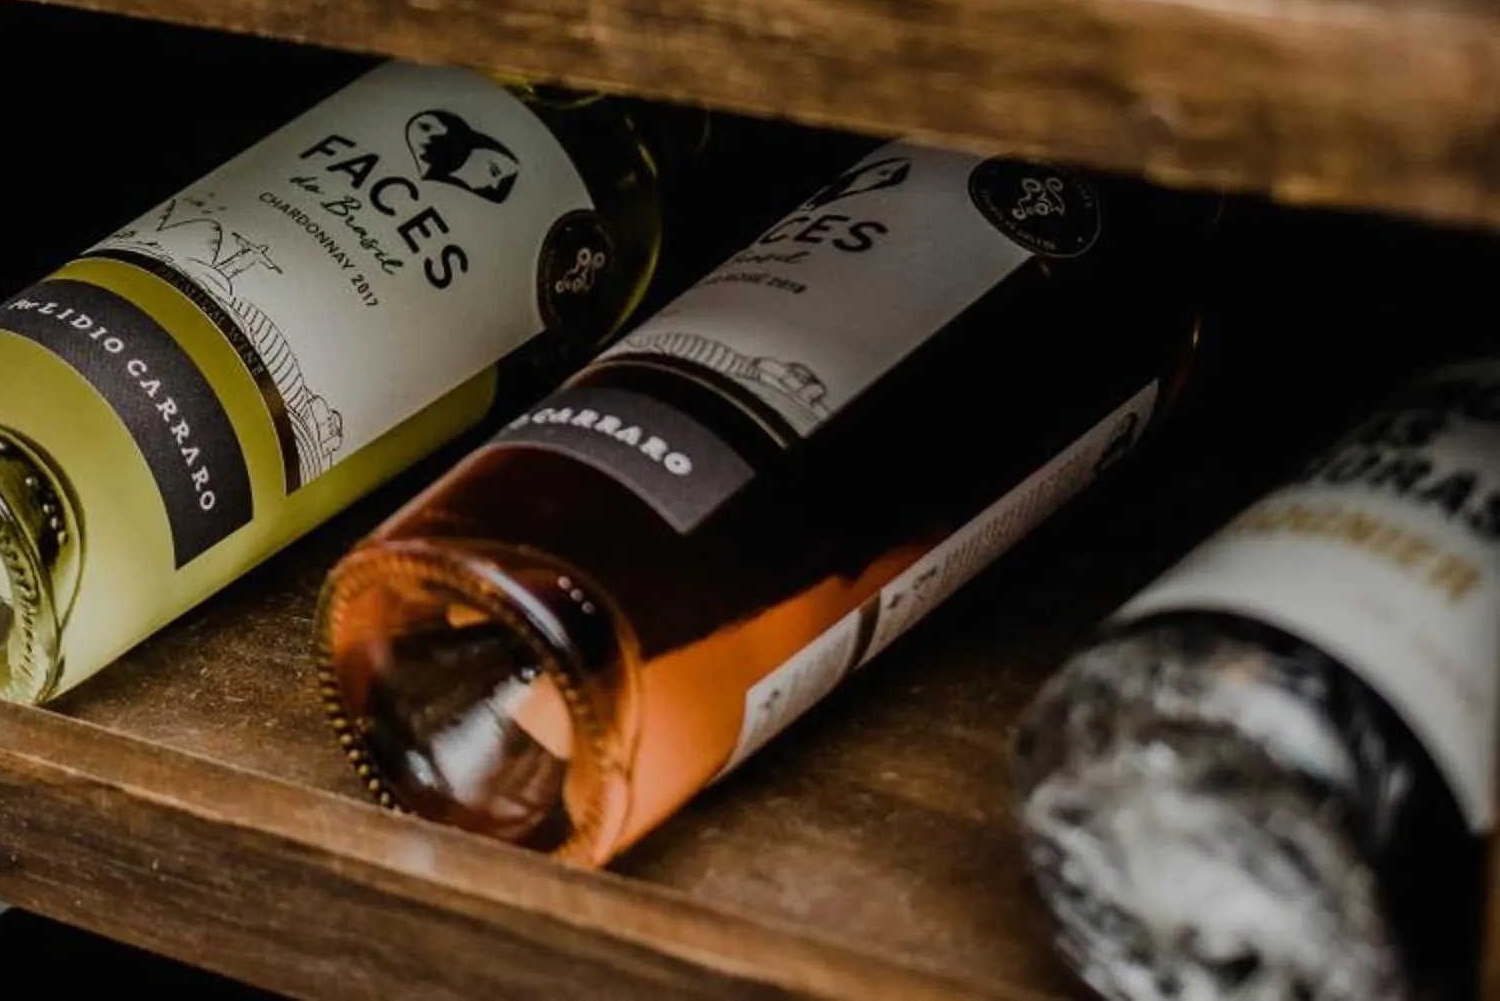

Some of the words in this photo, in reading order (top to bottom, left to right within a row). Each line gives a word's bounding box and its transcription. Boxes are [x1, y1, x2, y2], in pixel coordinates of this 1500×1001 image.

[259, 191, 355, 271] CHARDONNAY
[351, 273, 379, 308] 2017
[298, 134, 469, 290] FACES
[320, 195, 404, 276] Brasil
[37, 301, 125, 354] LIDIO
[126, 358, 216, 511] CARRARO
[531, 406, 694, 476] CARRARO
